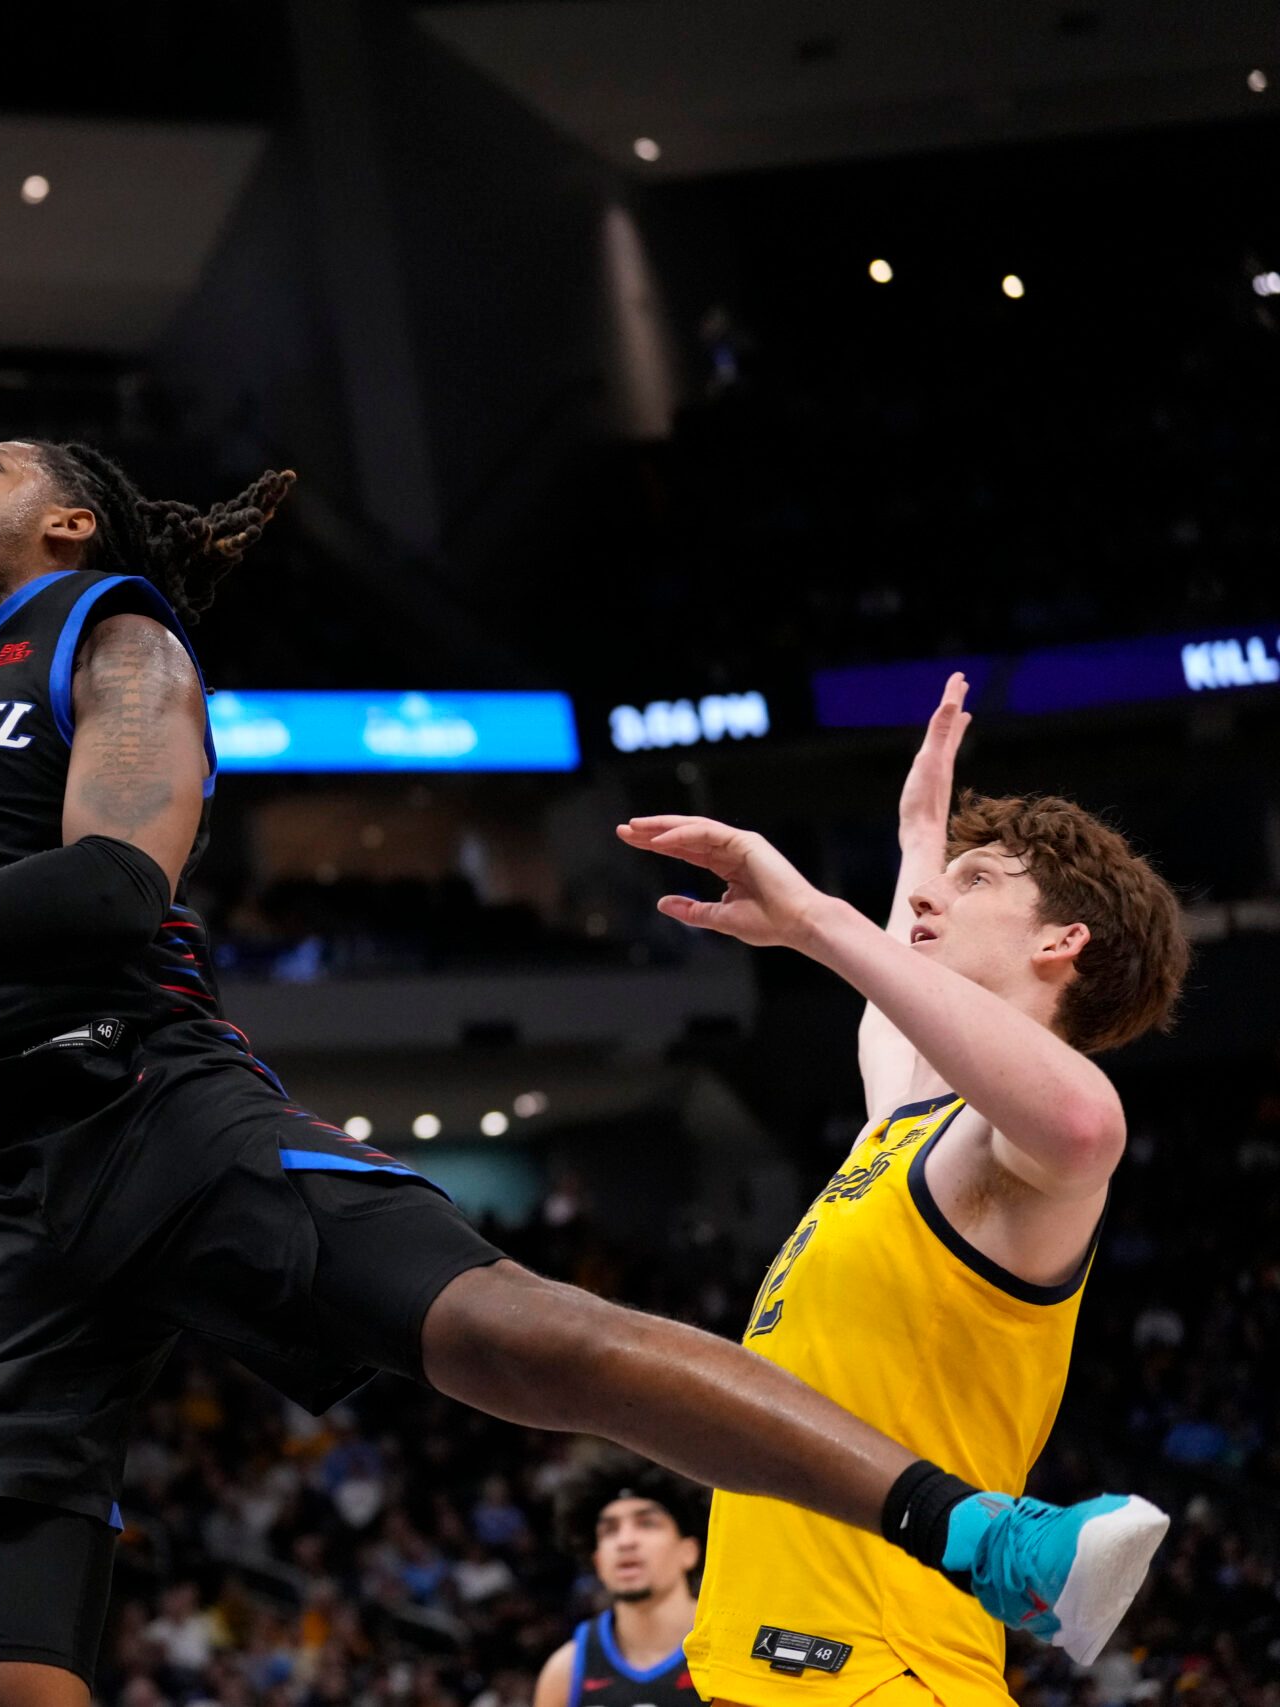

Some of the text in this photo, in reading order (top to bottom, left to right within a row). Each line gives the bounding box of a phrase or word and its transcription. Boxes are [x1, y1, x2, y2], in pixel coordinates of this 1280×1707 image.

[0, 641, 30, 654] BIG
[699, 690, 770, 742] PM
[97, 1023, 113, 1039] 46
[814, 1647, 833, 1661] 48
